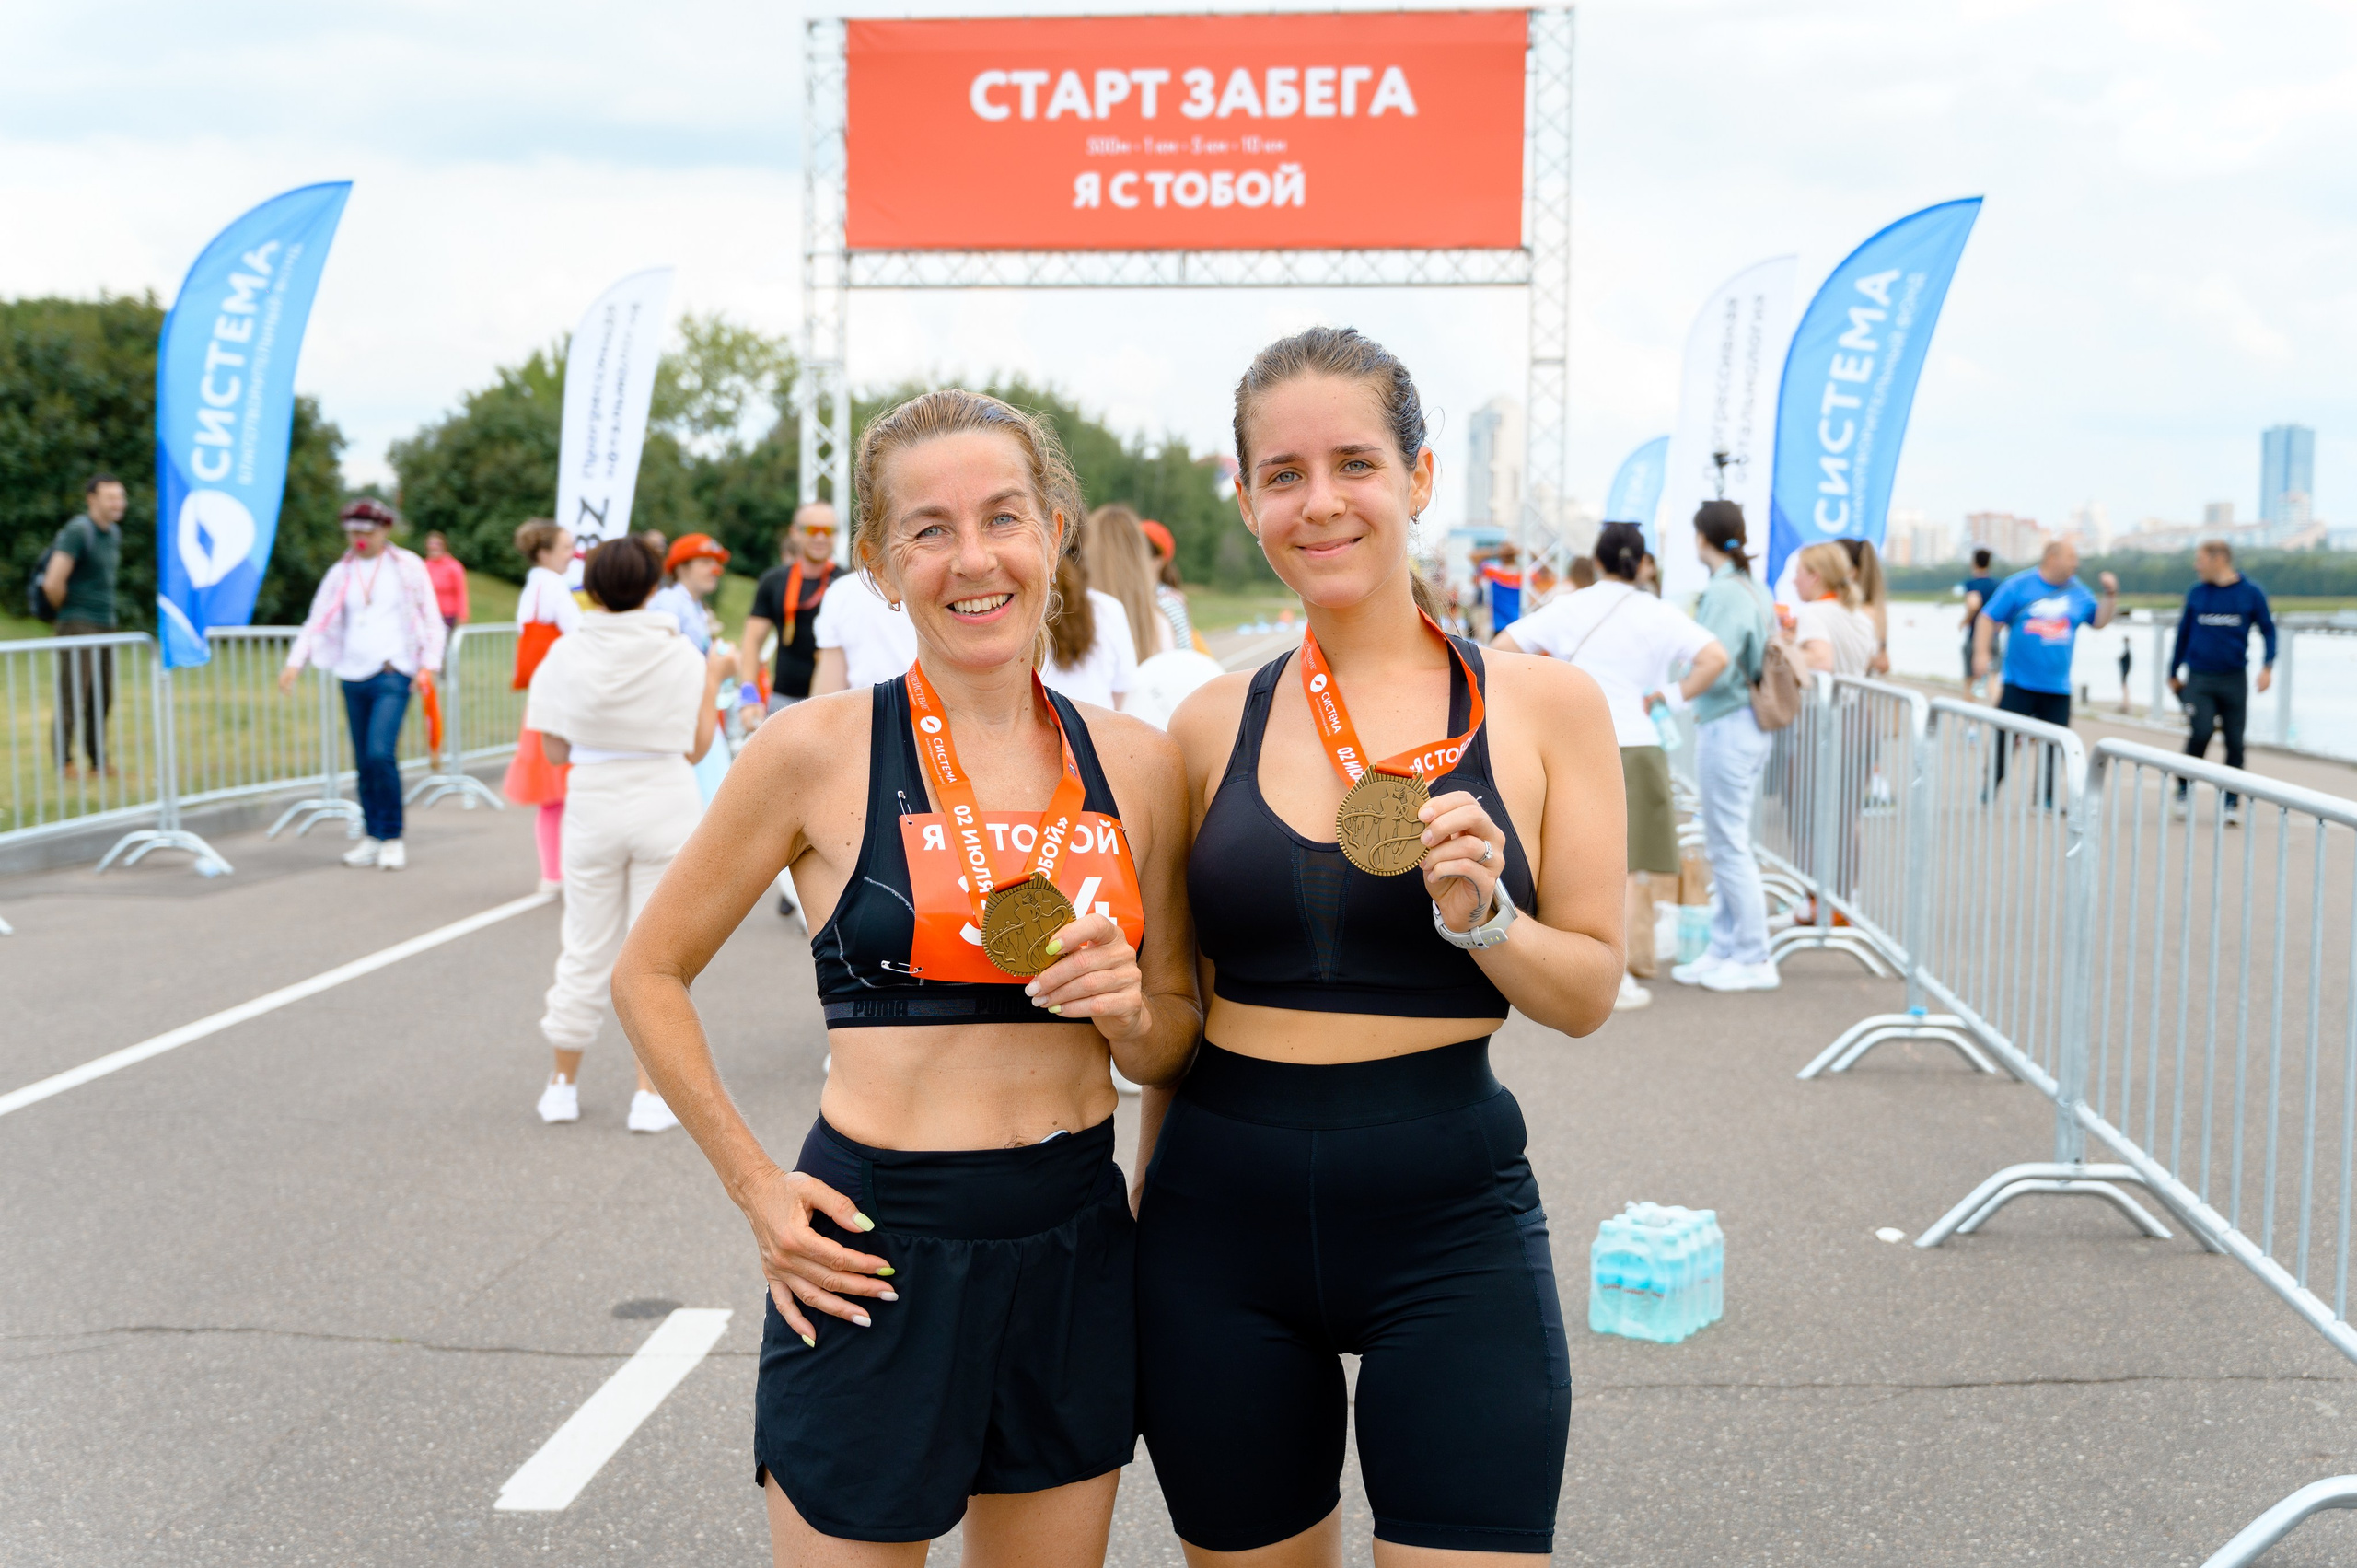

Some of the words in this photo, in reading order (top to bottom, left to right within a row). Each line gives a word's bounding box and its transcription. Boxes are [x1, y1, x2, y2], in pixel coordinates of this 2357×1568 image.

[969, 68, 1170, 121] СТАРТ
[1179, 65, 1418, 119] ЗАБЕГА
[1073, 171, 1100, 208] Я
[1109, 171, 1139, 208] С
[1144, 162, 1306, 208] ТОБОЙ
[190, 238, 281, 482] СИСТЕМА
[1813, 267, 1902, 534] СИСТЕМА
[1321, 691, 1342, 734] СИСТЕМА
[934, 738, 958, 783] СИСТЕМА
[1337, 747, 1356, 761] 02
[1424, 753, 1434, 771] С
[923, 824, 946, 851] Я
[986, 819, 1120, 854] ТООЙ
[954, 805, 973, 826] 02
[961, 830, 993, 893] ИЮЛЯ
[1035, 817, 1068, 880] ОБОЙ»
[853, 1000, 909, 1017] PUMA
